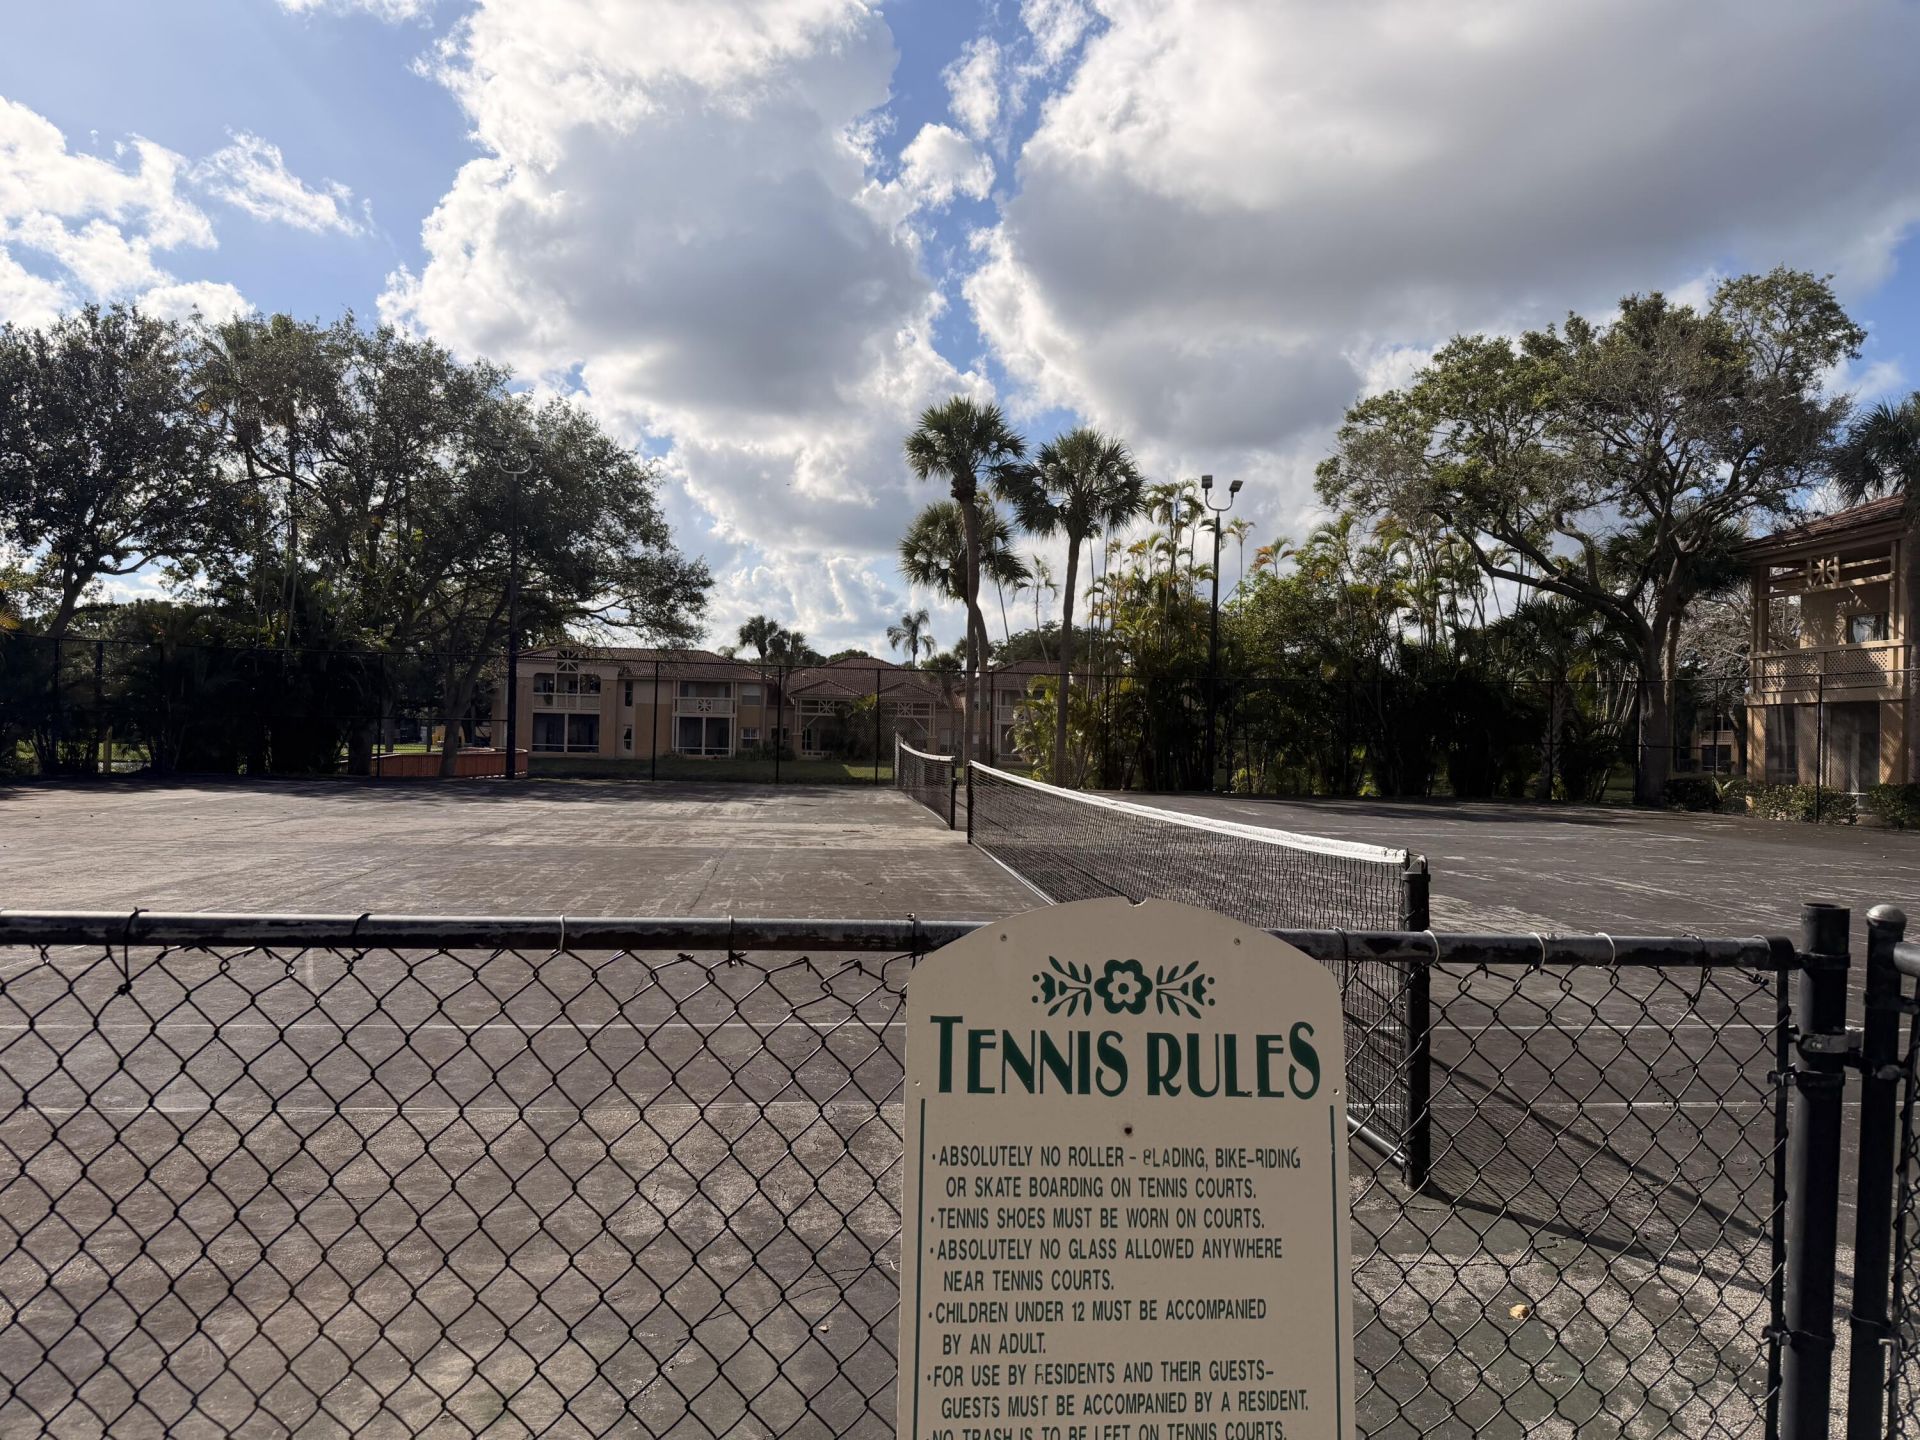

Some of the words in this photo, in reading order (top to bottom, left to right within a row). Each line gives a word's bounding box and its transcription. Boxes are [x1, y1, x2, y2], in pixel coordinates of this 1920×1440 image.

[930, 1015, 1129, 1097] TENNIS
[1146, 1021, 1321, 1100] RULES
[939, 1145, 1033, 1167] ABSOLUTELY
[1041, 1146, 1061, 1167] NO
[1068, 1146, 1124, 1167] ROLLER
[1215, 1146, 1301, 1169] BIKE-RIDING
[946, 1176, 967, 1197] OR
[975, 1176, 1021, 1197] SKATE
[1029, 1176, 1104, 1197] BOARDING
[1111, 1177, 1131, 1197] ON
[1138, 1177, 1188, 1198] TENNIS
[1195, 1178, 1257, 1198] COURTS.
[938, 1207, 989, 1229] TENNIS
[997, 1208, 1045, 1228] SHOES
[1053, 1208, 1092, 1228] MUST
[1100, 1208, 1118, 1228] BE
[1126, 1208, 1169, 1228] WORN
[1176, 1208, 1196, 1228] ON
[1204, 1208, 1265, 1228] COURTS.
[937, 1238, 1033, 1260] ABSOLUTELY
[1040, 1239, 1060, 1259] NO
[1069, 1238, 1117, 1259] GLASS
[1125, 1238, 1194, 1259] ALLOWED
[1202, 1238, 1283, 1259] ANYWHERE
[943, 1270, 984, 1291] NEAR
[993, 1270, 1043, 1291] TENNIS
[1051, 1269, 1114, 1290] COURTS.
[935, 1302, 1008, 1324] CHILDREN
[1015, 1301, 1064, 1323] UNDER
[1072, 1301, 1085, 1322] 12
[1093, 1300, 1132, 1321] MUST
[1139, 1299, 1157, 1321] BE
[1166, 1298, 1267, 1320] ACCOMPANIED
[943, 1334, 962, 1355] BY
[970, 1333, 991, 1354] AN
[999, 1332, 1046, 1354] ADULT.
[933, 1365, 963, 1387] FOR
[972, 1364, 1000, 1386] USE
[1008, 1364, 1027, 1386] BY
[1123, 1362, 1153, 1383] AND
[1161, 1360, 1201, 1382] THEIR
[1209, 1359, 1274, 1381] GUESTS-
[942, 1397, 1000, 1419] GUESTS
[1008, 1395, 1049, 1417] MUST
[1056, 1394, 1075, 1416] BE
[1083, 1391, 1187, 1416] ACCOMPANIED
[1195, 1391, 1213, 1413] BY
[1221, 1391, 1231, 1412] A
[1238, 1389, 1309, 1411] RESIDENT.
[1041, 1426, 1060, 1440] TO
[1069, 1425, 1087, 1440] BE
[1095, 1424, 1131, 1440] LEFT
[1139, 1424, 1159, 1440] ON
[1167, 1422, 1217, 1440] TENNIS
[1225, 1421, 1287, 1440] COURTS.
